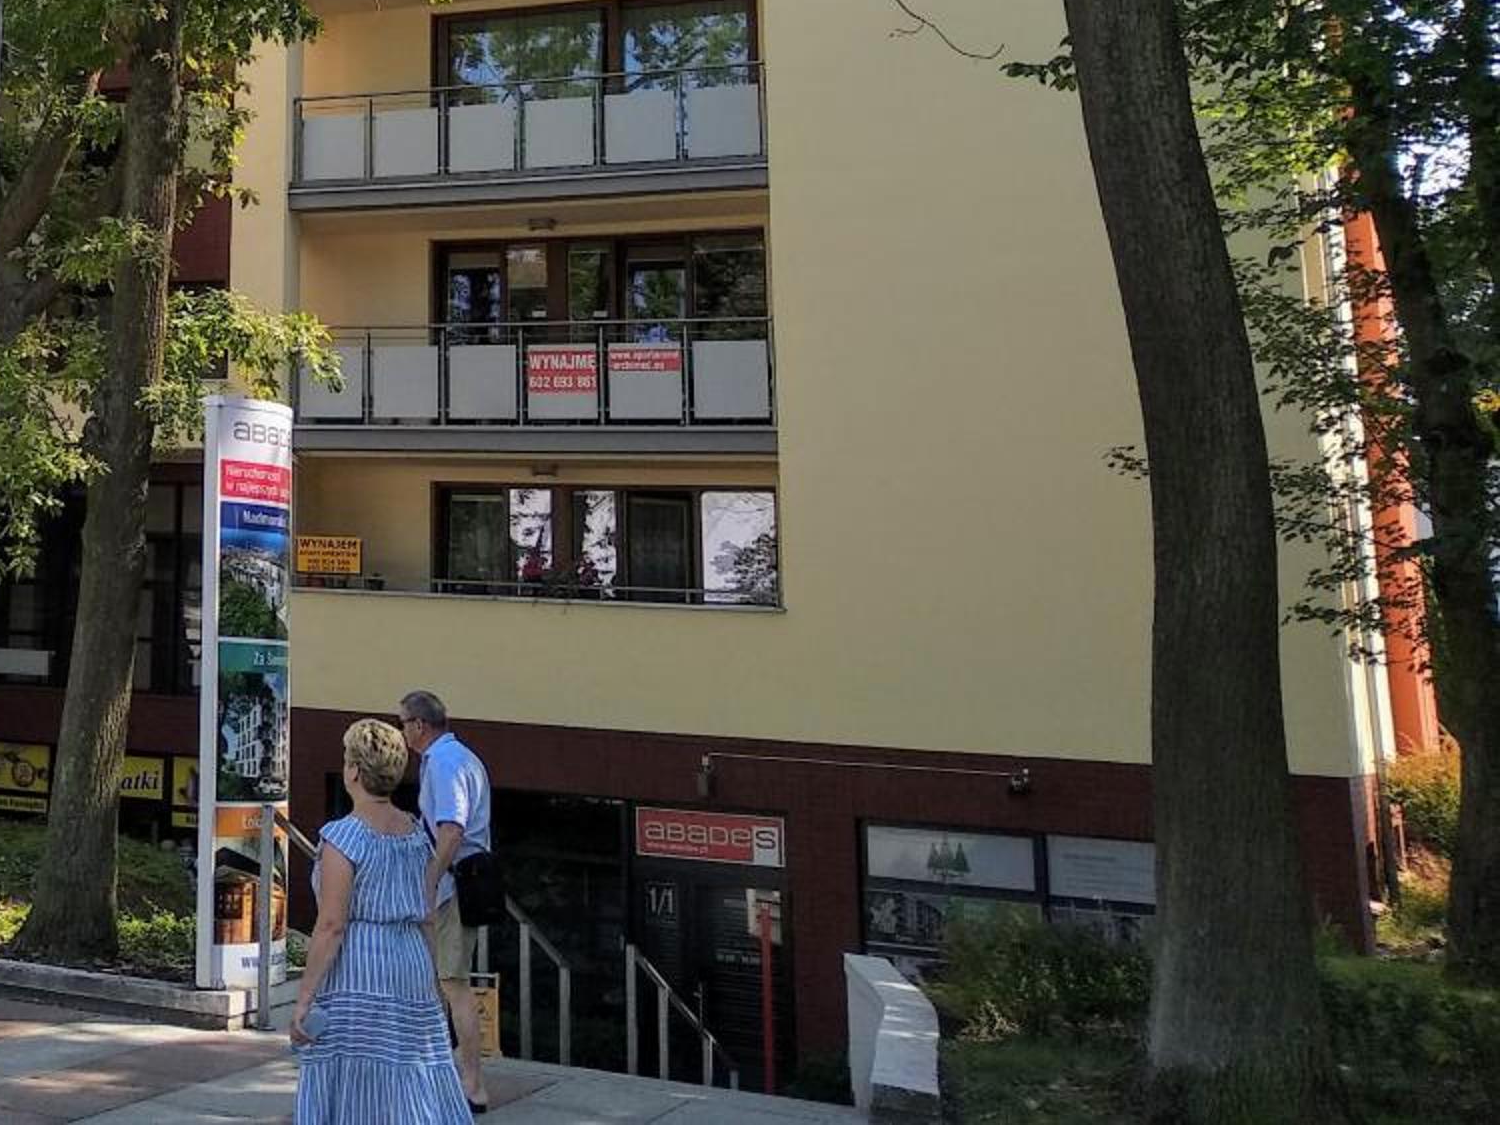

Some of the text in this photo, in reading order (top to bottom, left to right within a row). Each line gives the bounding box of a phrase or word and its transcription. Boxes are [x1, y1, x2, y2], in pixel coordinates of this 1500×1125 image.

[529, 353, 597, 373] WYNAJMĘ
[300, 539, 357, 549] WYNAJEM
[650, 886, 674, 916] 1/1
